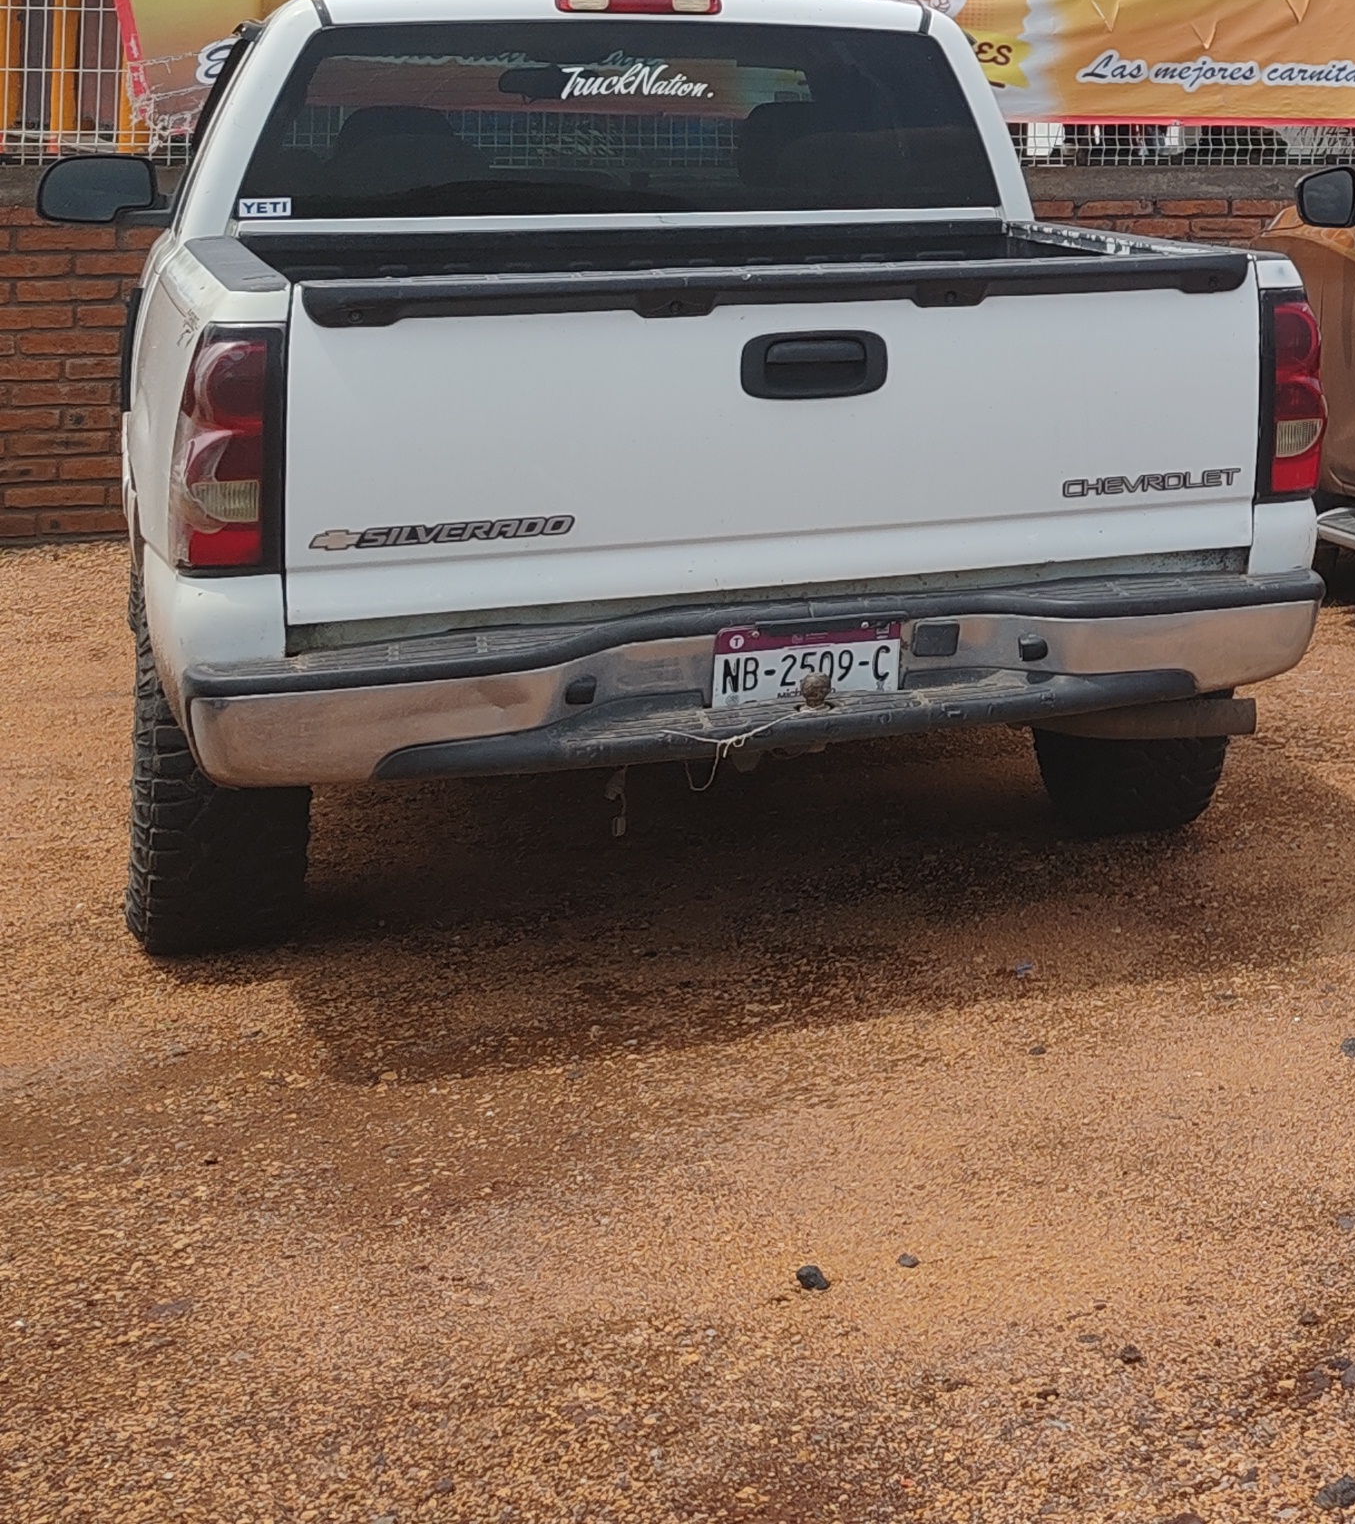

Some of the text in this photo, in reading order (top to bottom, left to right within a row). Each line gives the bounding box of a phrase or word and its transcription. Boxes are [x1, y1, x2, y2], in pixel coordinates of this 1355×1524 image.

[1083, 54, 1143, 80] Las
[1154, 62, 1256, 87] mejores
[241, 200, 290, 214] YETI
[1062, 467, 1242, 498] CHEVROLET
[357, 515, 575, 549] SILVERADO
[732, 637, 741, 648] T
[721, 645, 891, 695] NB-2509-C
